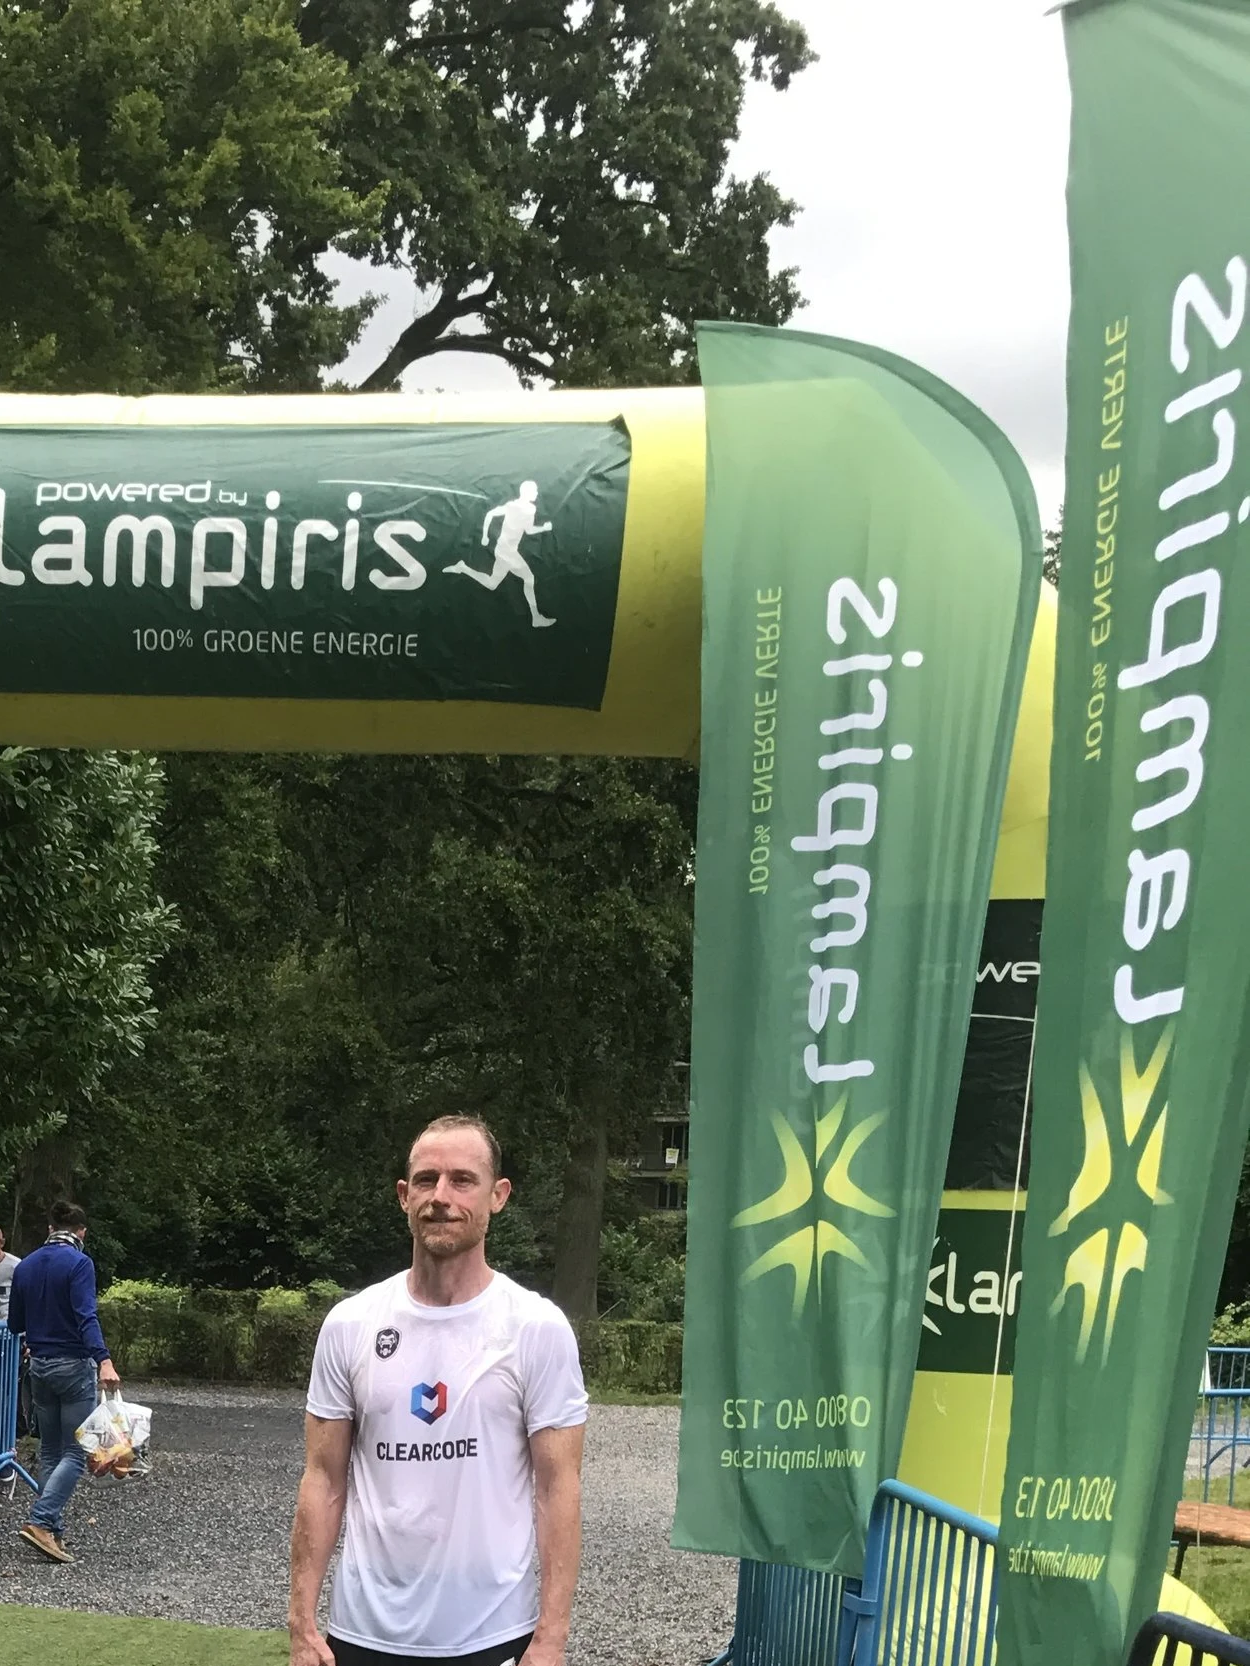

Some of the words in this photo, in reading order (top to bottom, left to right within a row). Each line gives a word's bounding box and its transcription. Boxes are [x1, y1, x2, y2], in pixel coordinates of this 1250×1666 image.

[36, 479, 212, 507] powered
[218, 488, 248, 507] by
[132, 628, 194, 652] 100%
[204, 629, 303, 655] GROENE
[313, 631, 418, 658] ENERGIE
[376, 1438, 478, 1462] CLEARCODE
